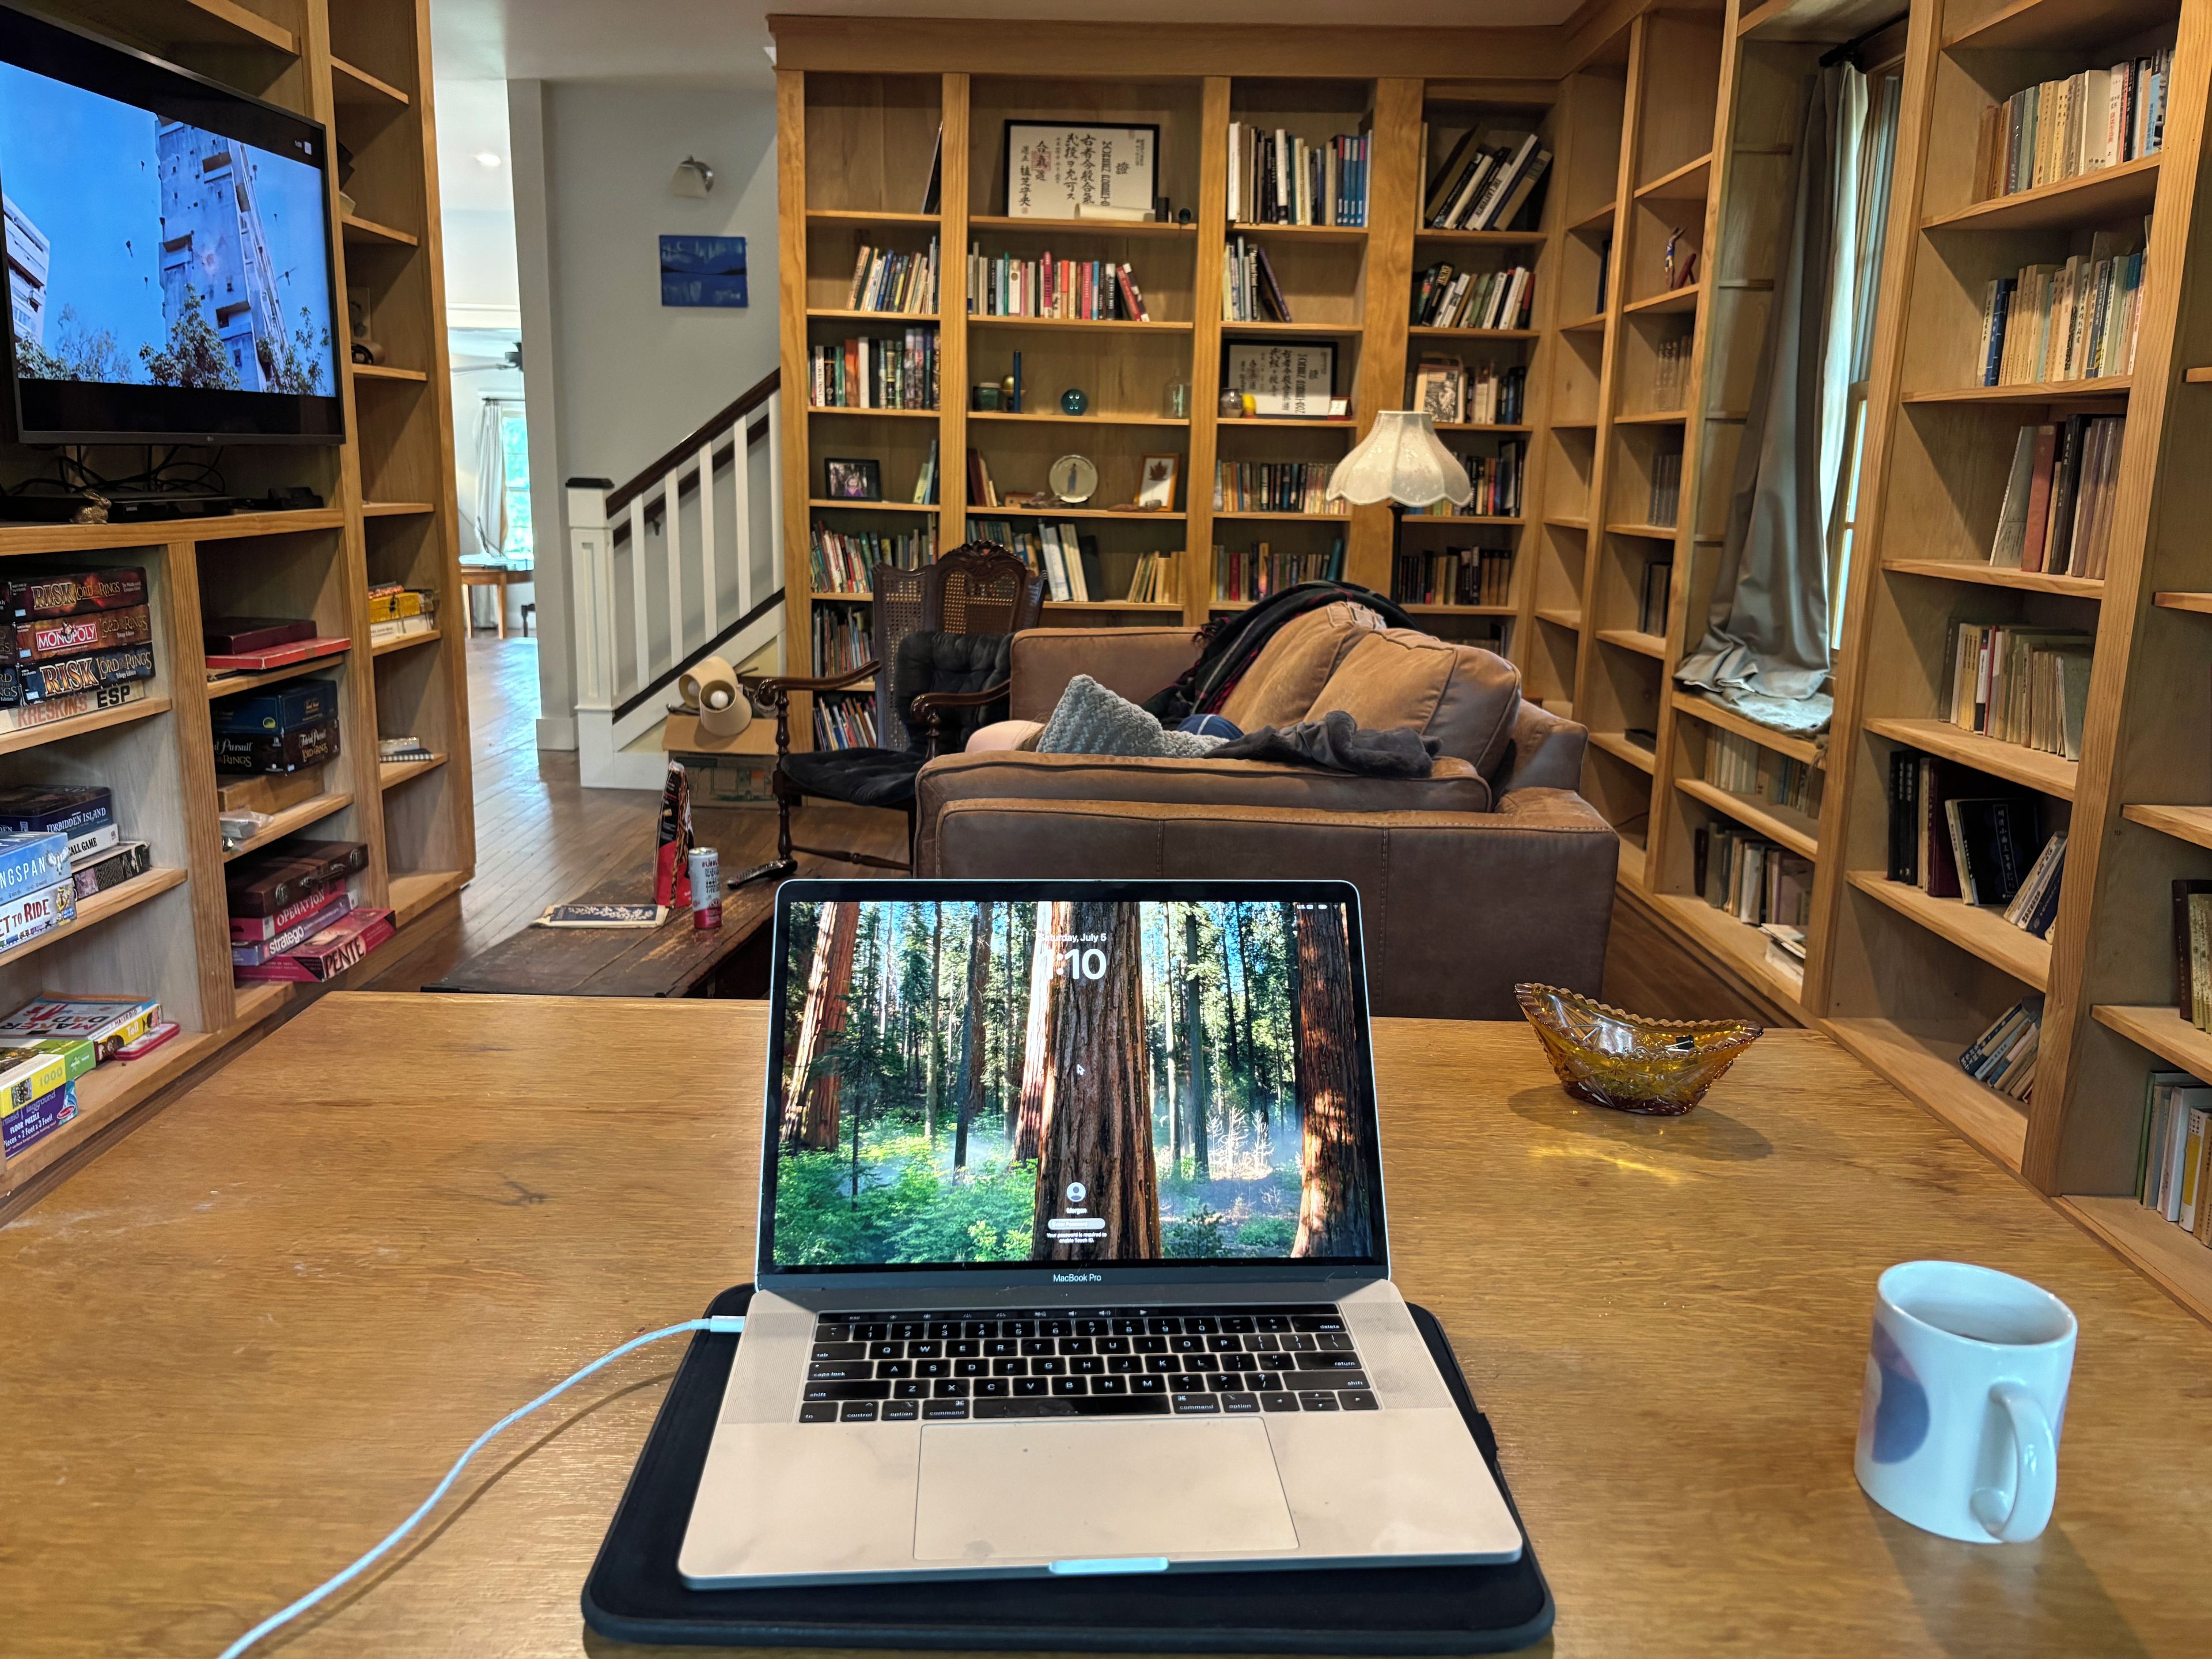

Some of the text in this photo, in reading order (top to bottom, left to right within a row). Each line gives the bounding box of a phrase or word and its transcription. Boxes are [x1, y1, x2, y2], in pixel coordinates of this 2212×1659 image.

[31, 582, 77, 610] RISK
[99, 582, 120, 597] RINGS
[38, 626, 94, 648] MONOPOLY
[124, 615, 148, 631] RINGS
[39, 658, 99, 696] RISK
[96, 657, 119, 680] LORD
[124, 652, 151, 669] RINGS
[97, 685, 130, 708] ESP
[221, 738, 253, 754] Pursuit
[224, 755, 252, 767] RINGS
[46, 808, 106, 832] FORBIDDEN ISLAND
[82, 838, 97, 851] GAME
[12, 912, 22, 927] TO
[24, 899, 50, 923] RIDE
[277, 889, 325, 926] OPERATION
[269, 925, 304, 955] stratego
[1038, 933, 1107, 943] Saturday, July 5
[323, 937, 364, 978] PENTE
[1040, 948, 1107, 980] 1:10
[40, 1066, 63, 1086] 1000
[10, 1112, 40, 1134] FLOOR PUZZLE
[21, 1130, 25, 1138] 2
[25, 1125, 35, 1135] Feet
[38, 1119, 42, 1128] 3
[1053, 1274, 1102, 1282] MacBook Pro
